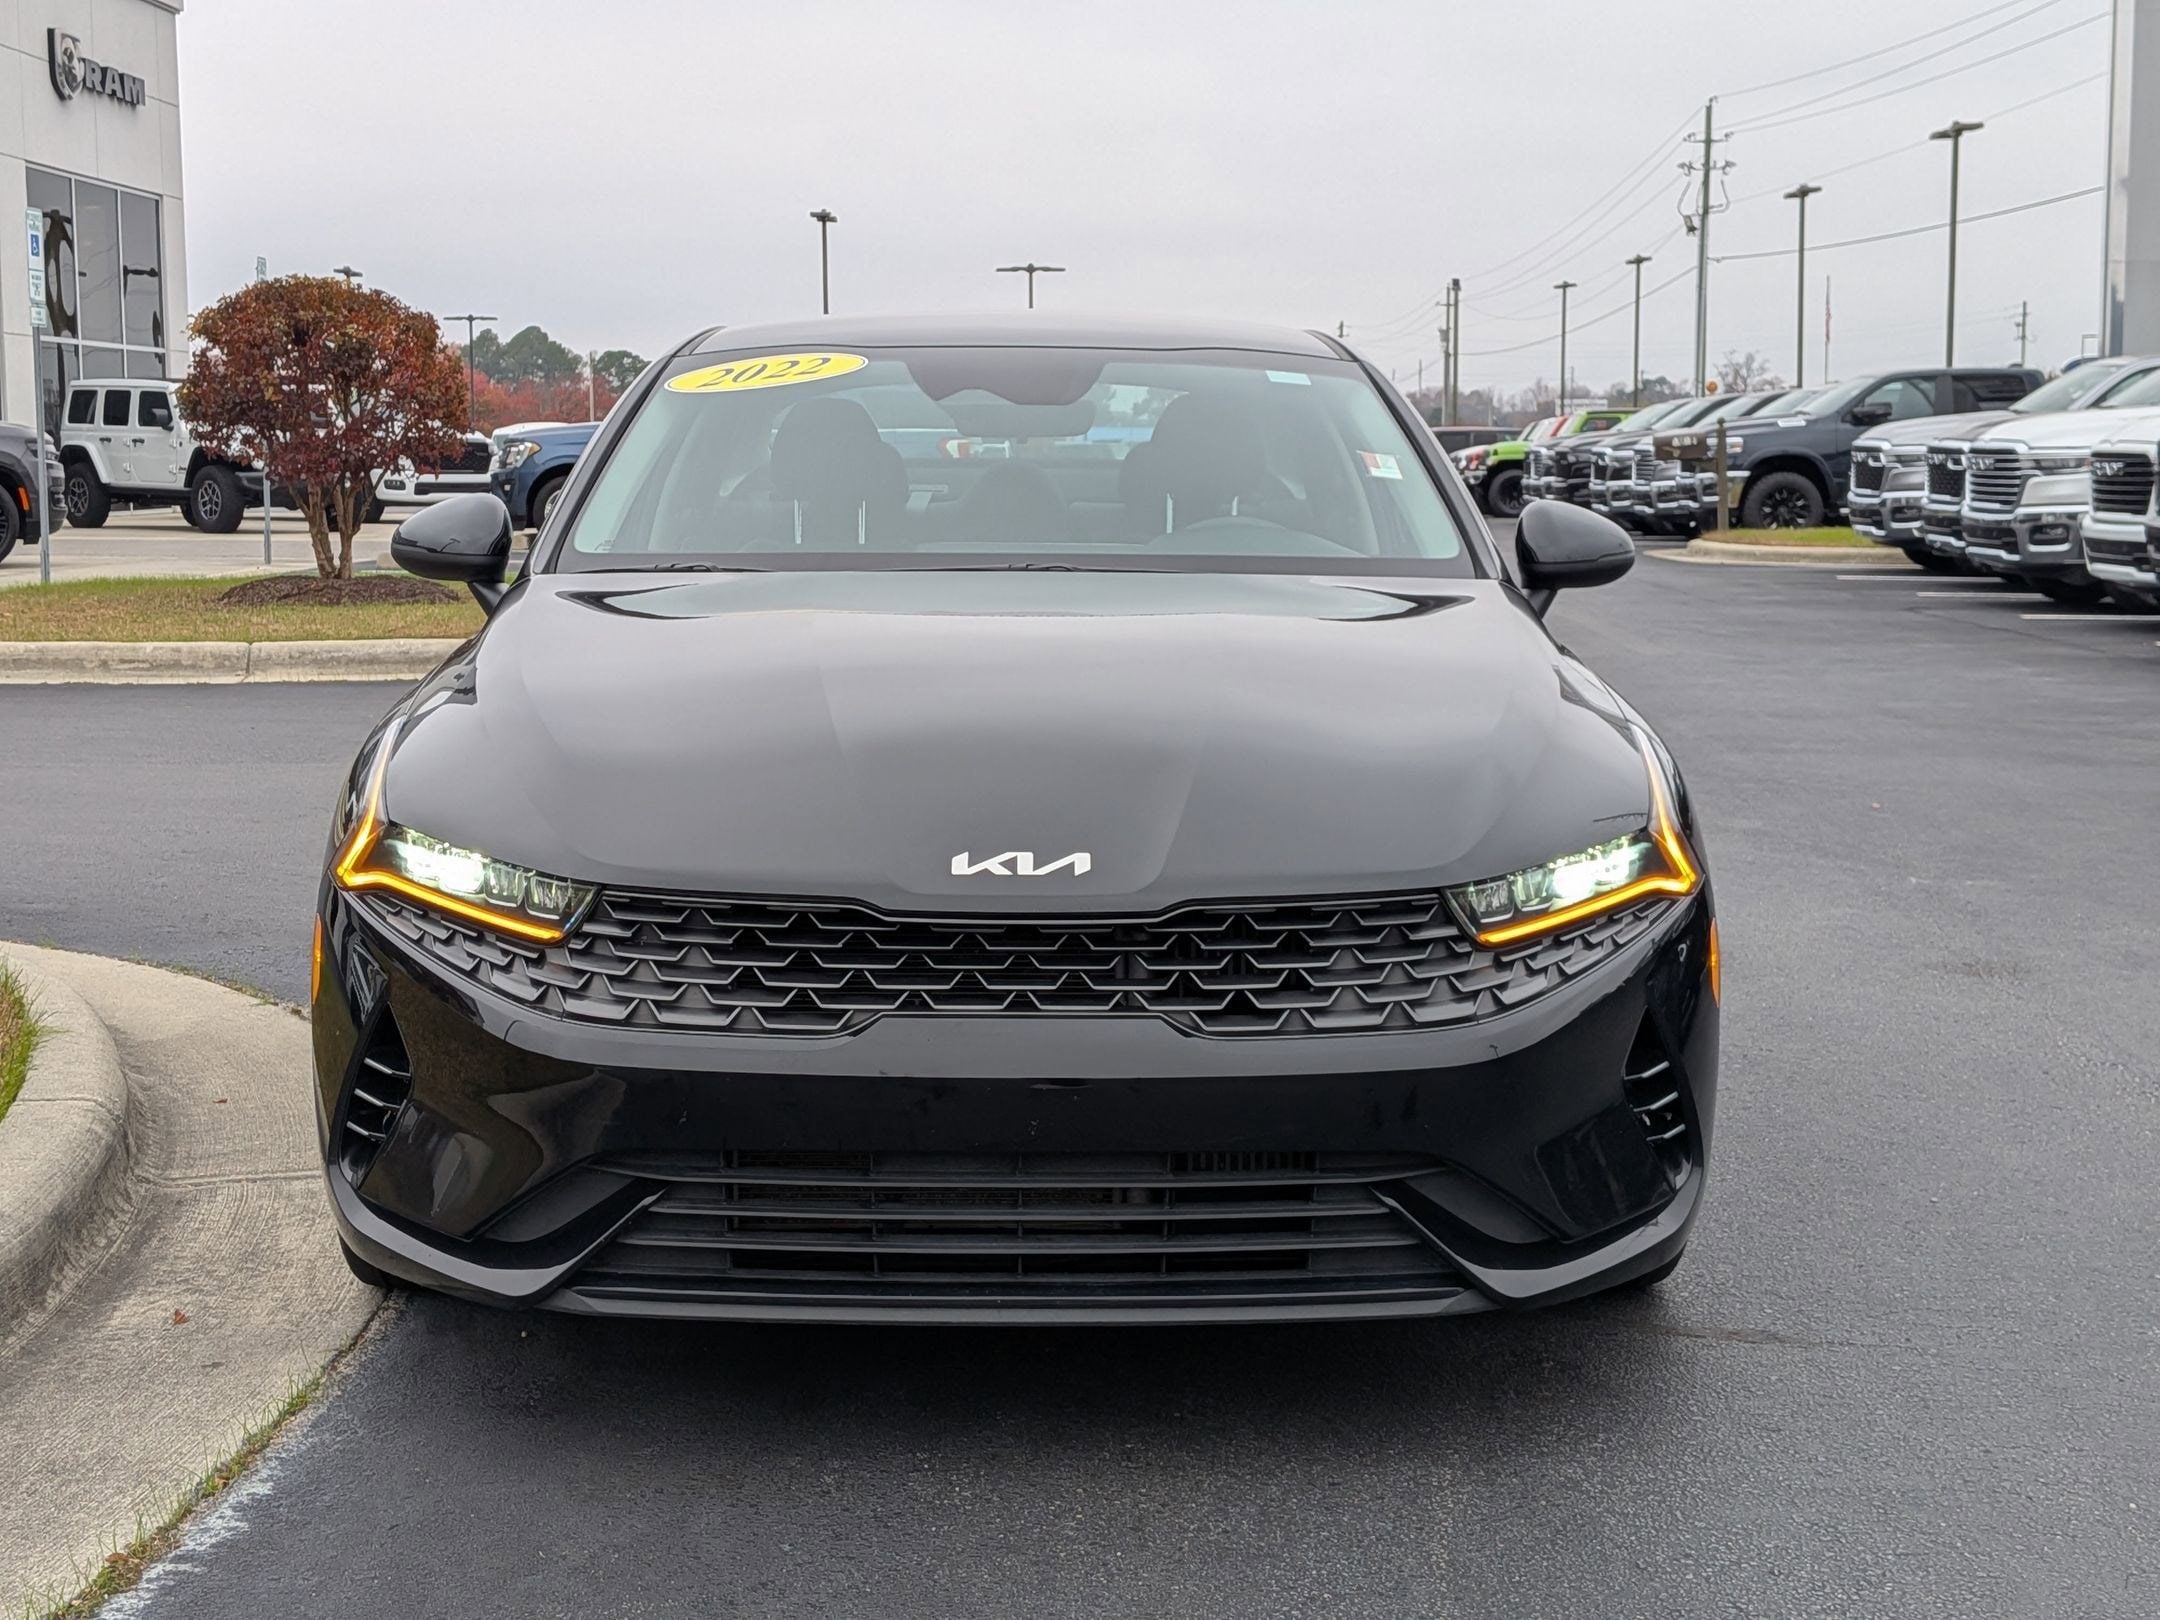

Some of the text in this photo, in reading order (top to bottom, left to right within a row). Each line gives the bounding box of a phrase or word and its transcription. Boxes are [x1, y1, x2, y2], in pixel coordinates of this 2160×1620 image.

[84, 58, 146, 106] RAM
[696, 357, 832, 388] 2022
[951, 851, 1091, 876] KIA
